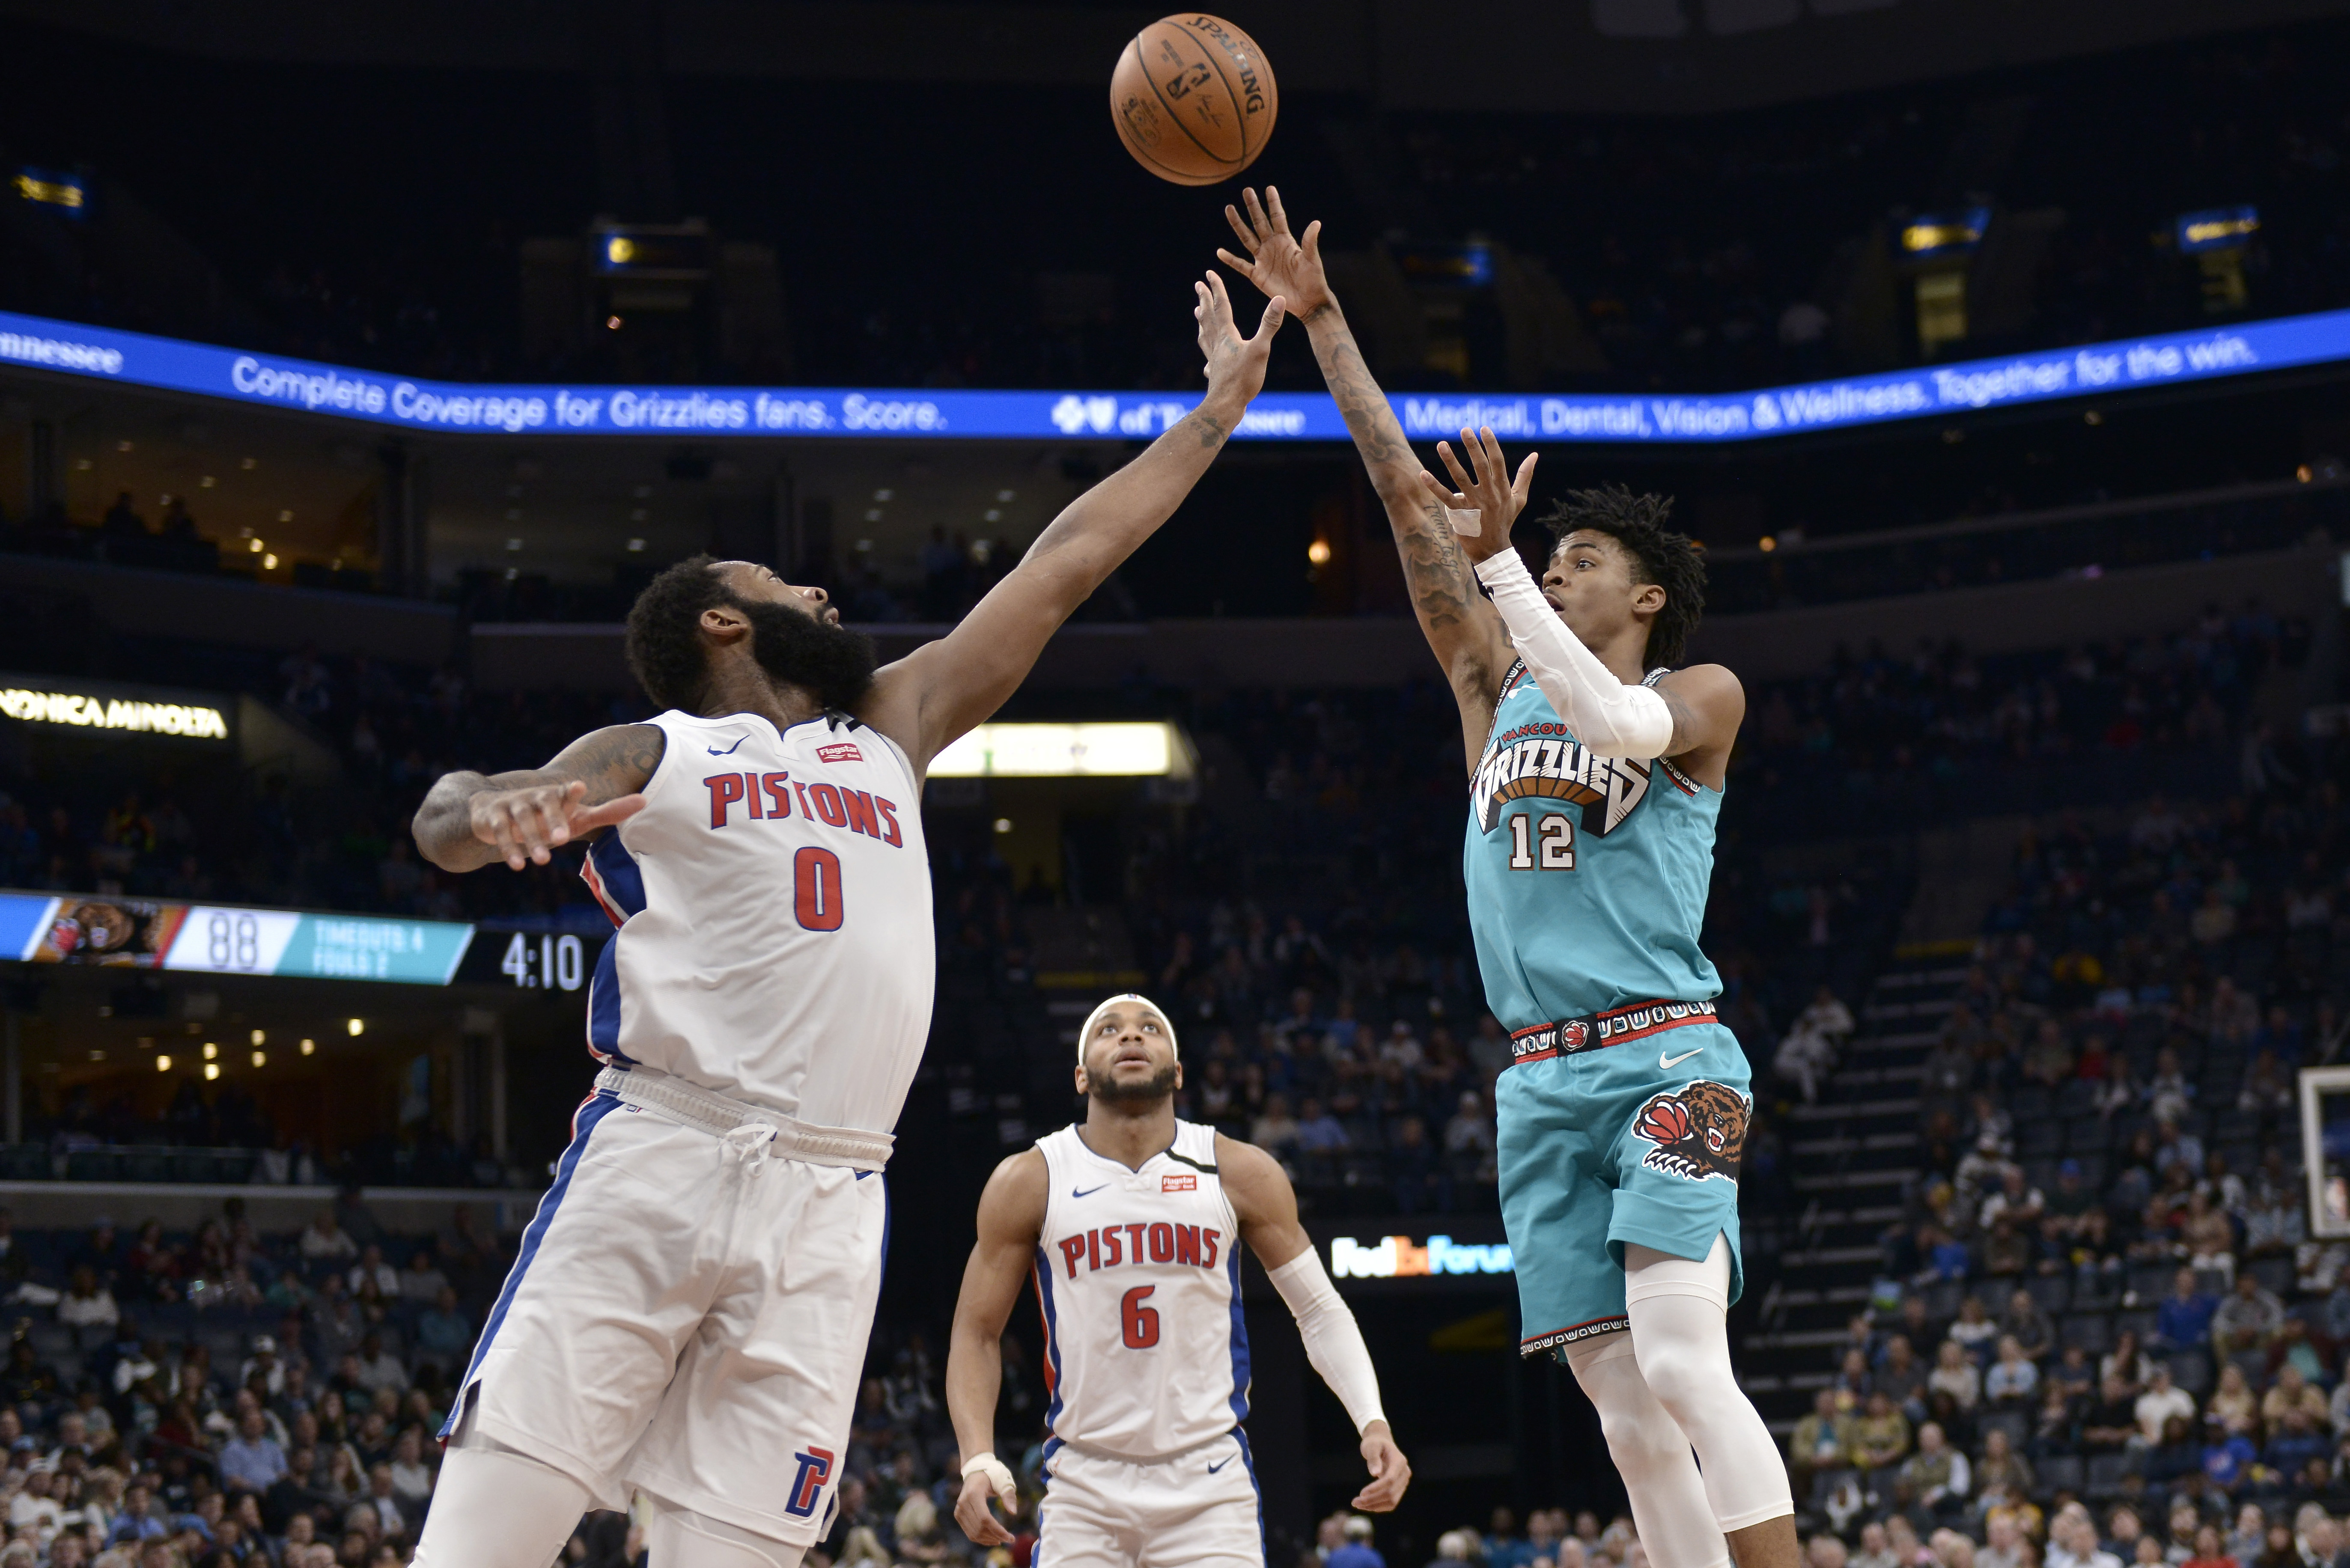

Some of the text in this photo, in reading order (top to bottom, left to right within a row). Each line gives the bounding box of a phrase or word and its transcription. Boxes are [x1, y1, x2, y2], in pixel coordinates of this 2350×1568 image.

[1185, 16, 1265, 116] SPALDING
[232, 356, 385, 414] Complete
[391, 382, 548, 432] Coverage
[555, 390, 602, 426] for
[608, 390, 749, 428] Grizzlies
[1404, 398, 1536, 438] Medical,
[1541, 398, 1652, 439] Dental,
[1651, 399, 1749, 435] Vision
[1751, 393, 1781, 431] &
[1931, 360, 2070, 408] Together
[2075, 350, 2121, 386] for
[2127, 344, 2184, 380] the
[106, 698, 228, 739] MINOLTA
[1501, 722, 1573, 744] VANCOU
[703, 771, 903, 849] PISTONS
[1474, 736, 1652, 839] GRIZZLIES
[1508, 812, 1576, 872] 12
[793, 846, 844, 932] 0
[209, 912, 258, 972] 88
[501, 931, 584, 991] 4:10
[1163, 1176, 1194, 1185] Flagstar
[1057, 1223, 1221, 1279] PISTONS
[1120, 1284, 1160, 1349] 6
